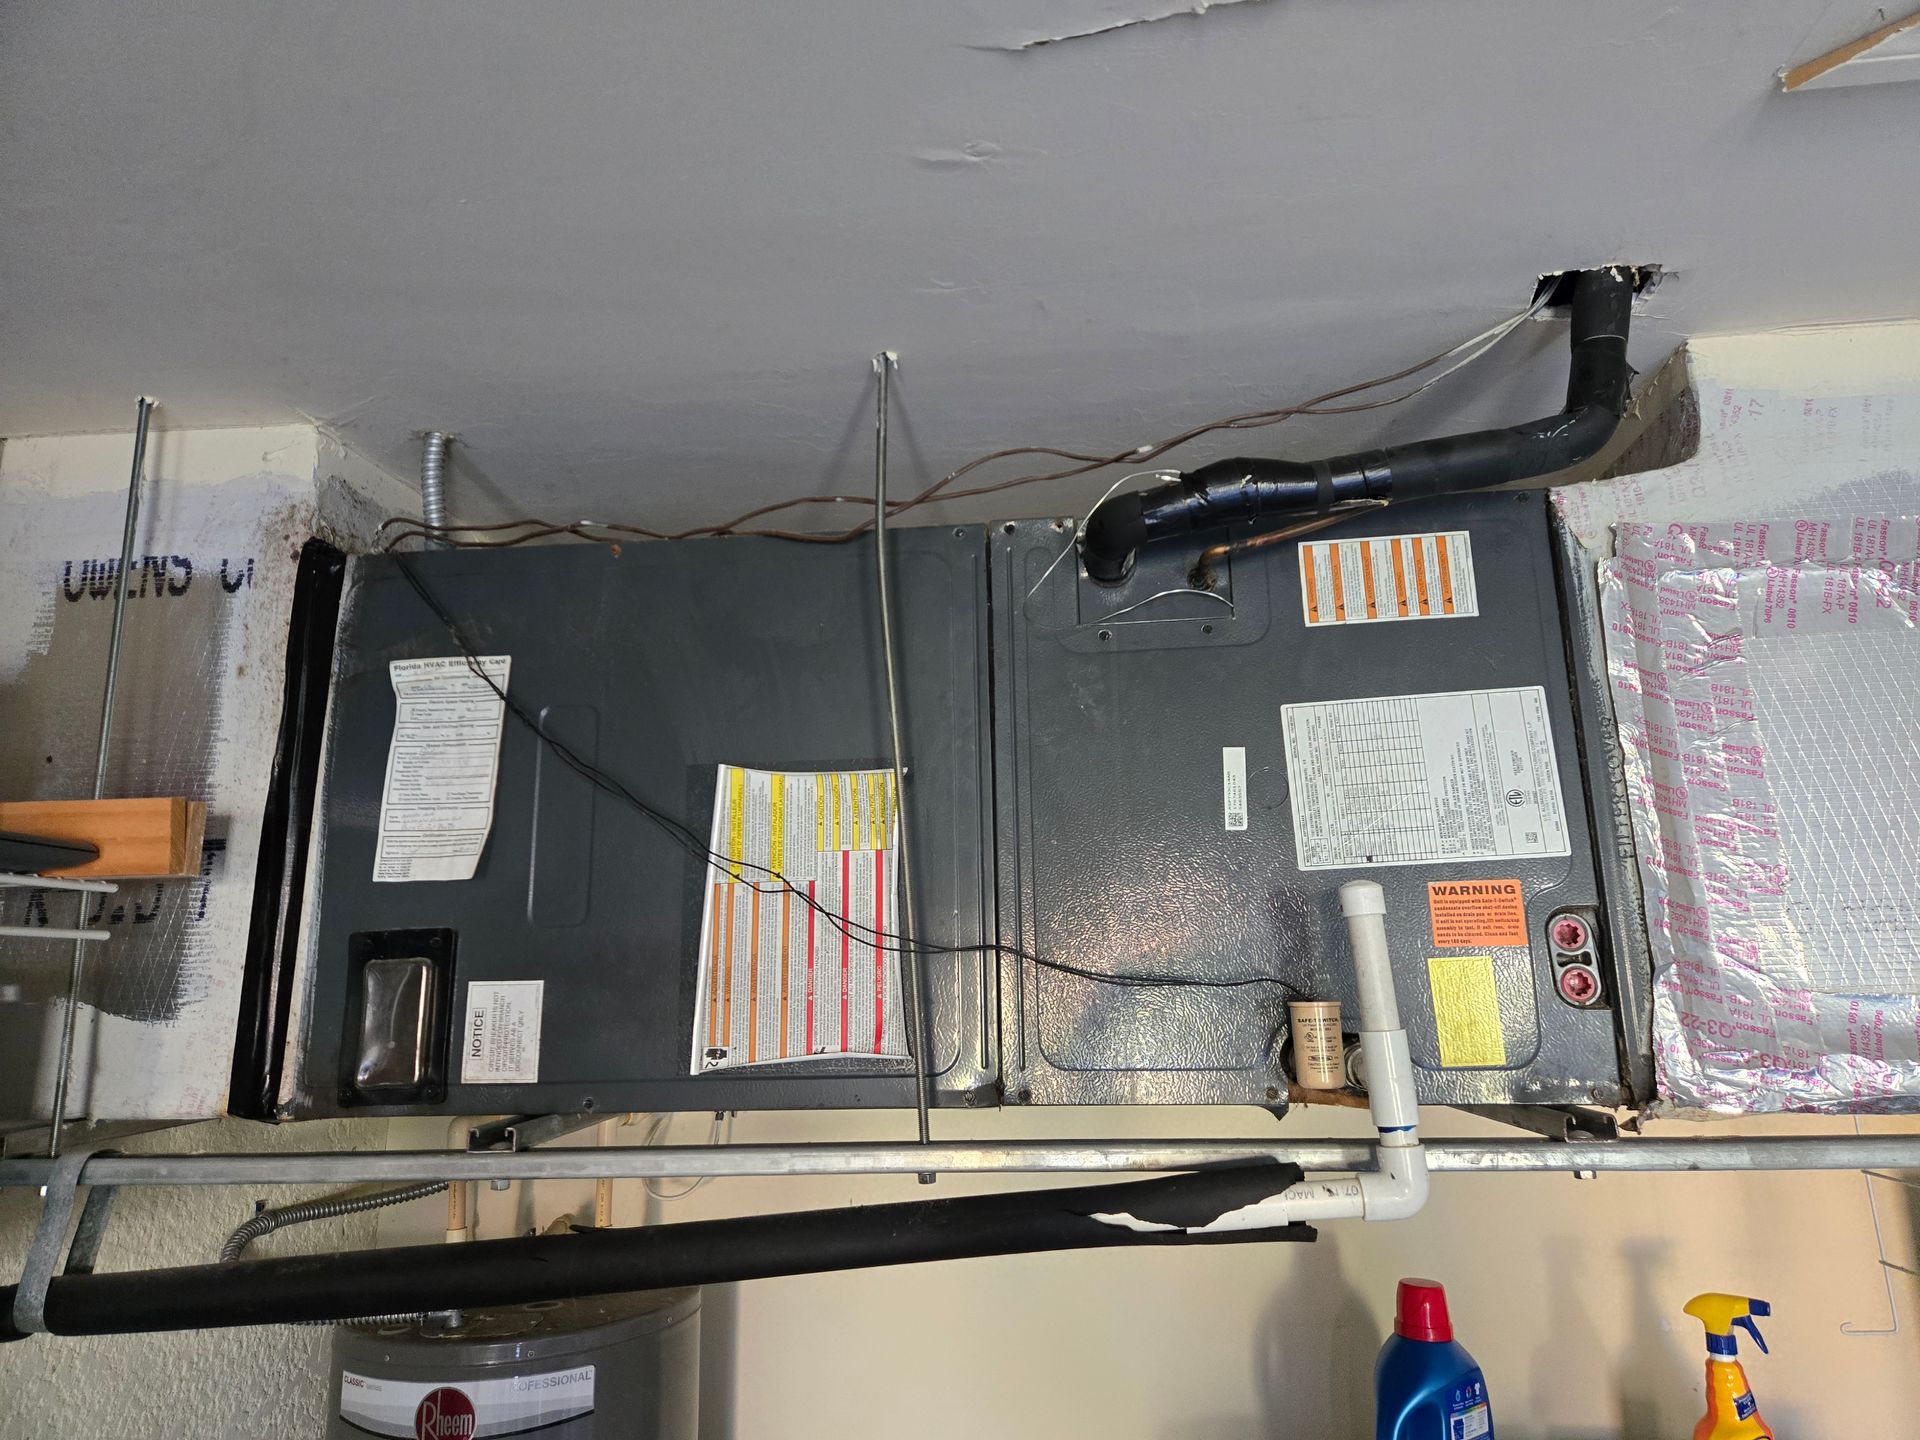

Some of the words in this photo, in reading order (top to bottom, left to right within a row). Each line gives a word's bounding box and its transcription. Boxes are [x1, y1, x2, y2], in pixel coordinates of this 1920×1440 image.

[1746, 524, 1756, 535] UL
[1776, 568, 1788, 609] MH14352
[1786, 608, 1797, 629] 0810
[1848, 602, 1857, 624] 0810
[424, 661, 446, 669] HVAC
[1711, 683, 1735, 694] 181B
[1432, 885, 1515, 895] WARNING
[1847, 1001, 1859, 1024] 0810
[471, 1010, 484, 1057] NOTICE
[1680, 1011, 1733, 1039] Q3-22
[344, 1375, 364, 1389] CLASSIC
[422, 1390, 473, 1440] Rheem
